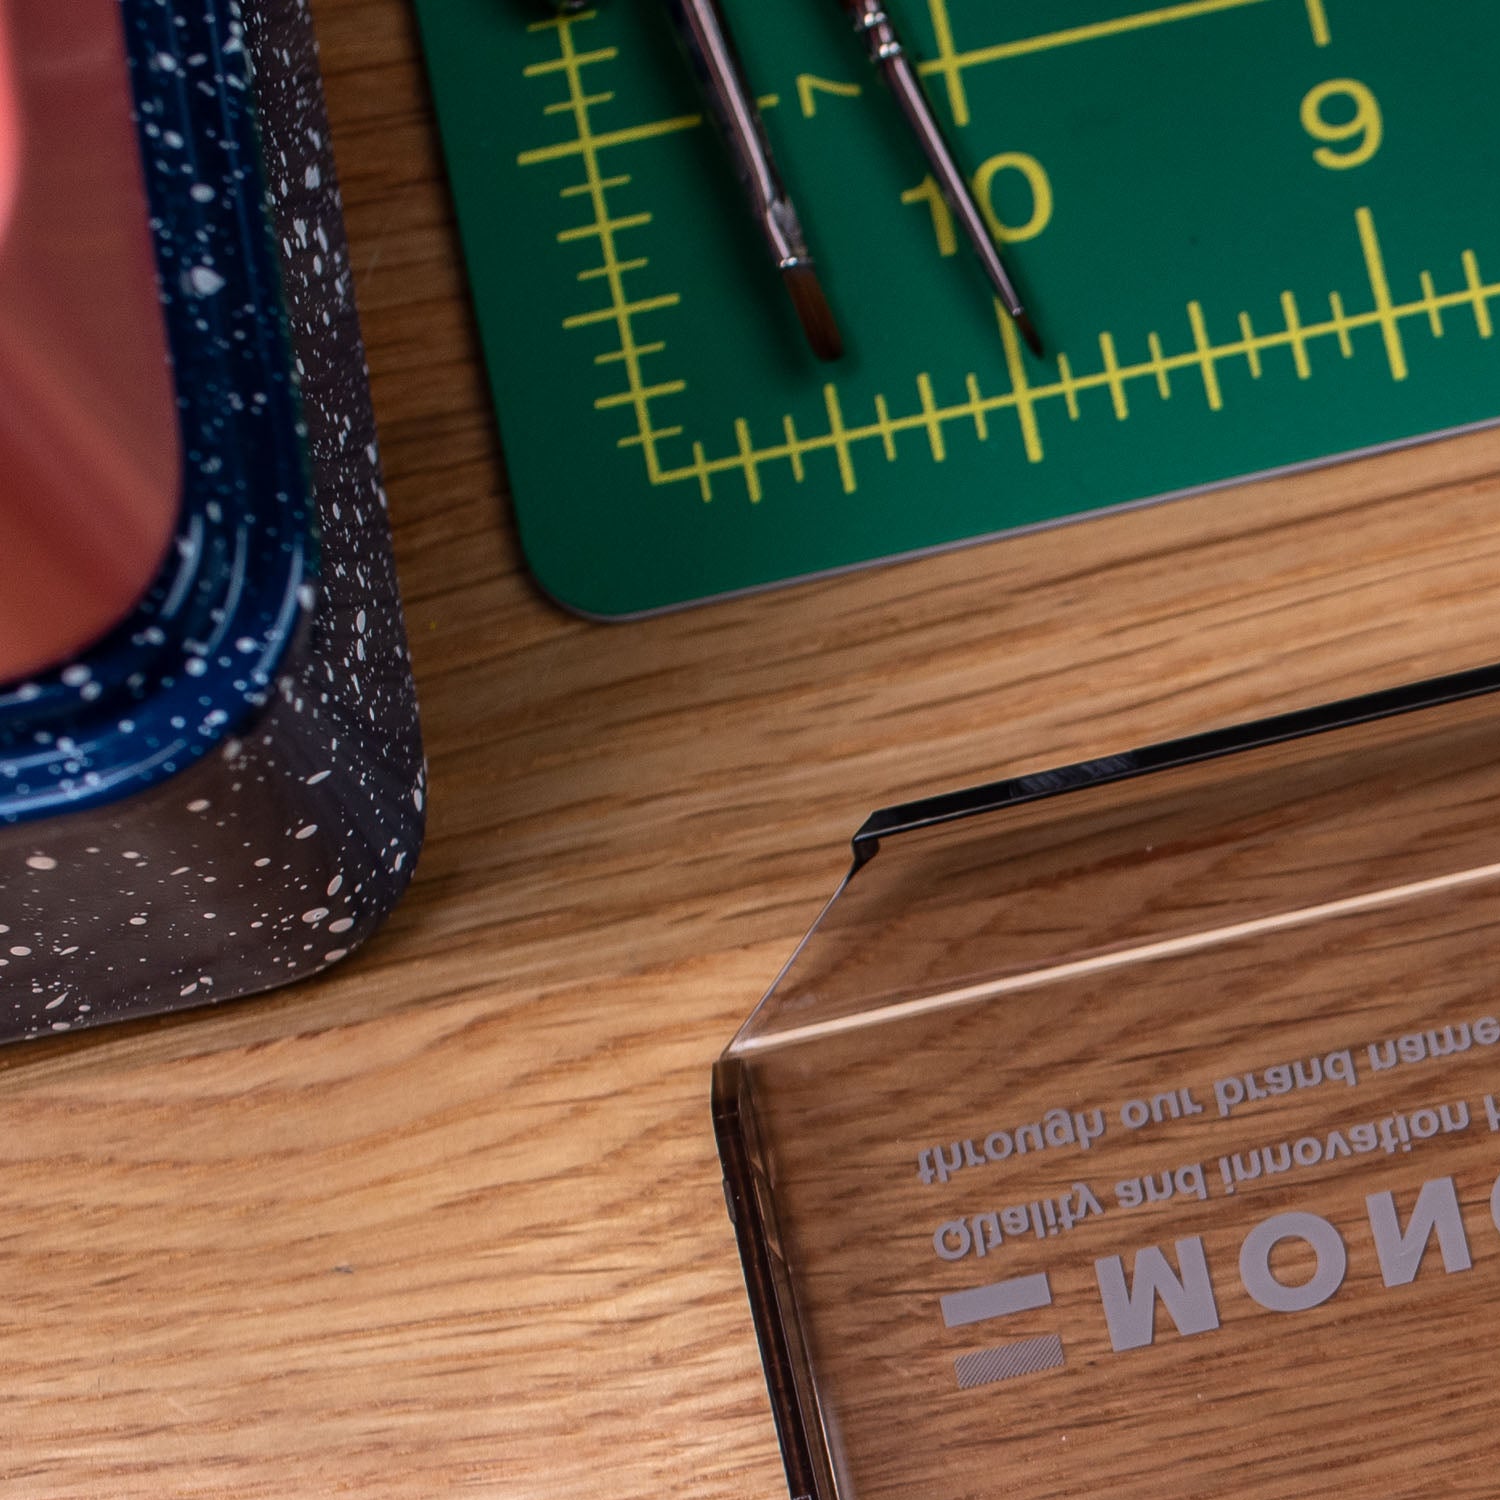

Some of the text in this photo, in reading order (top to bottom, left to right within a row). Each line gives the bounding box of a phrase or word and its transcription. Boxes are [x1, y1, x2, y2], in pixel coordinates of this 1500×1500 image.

[796, 73, 862, 117] 7
[1300, 79, 1384, 170] 9
[902, 151, 1053, 257] 10
